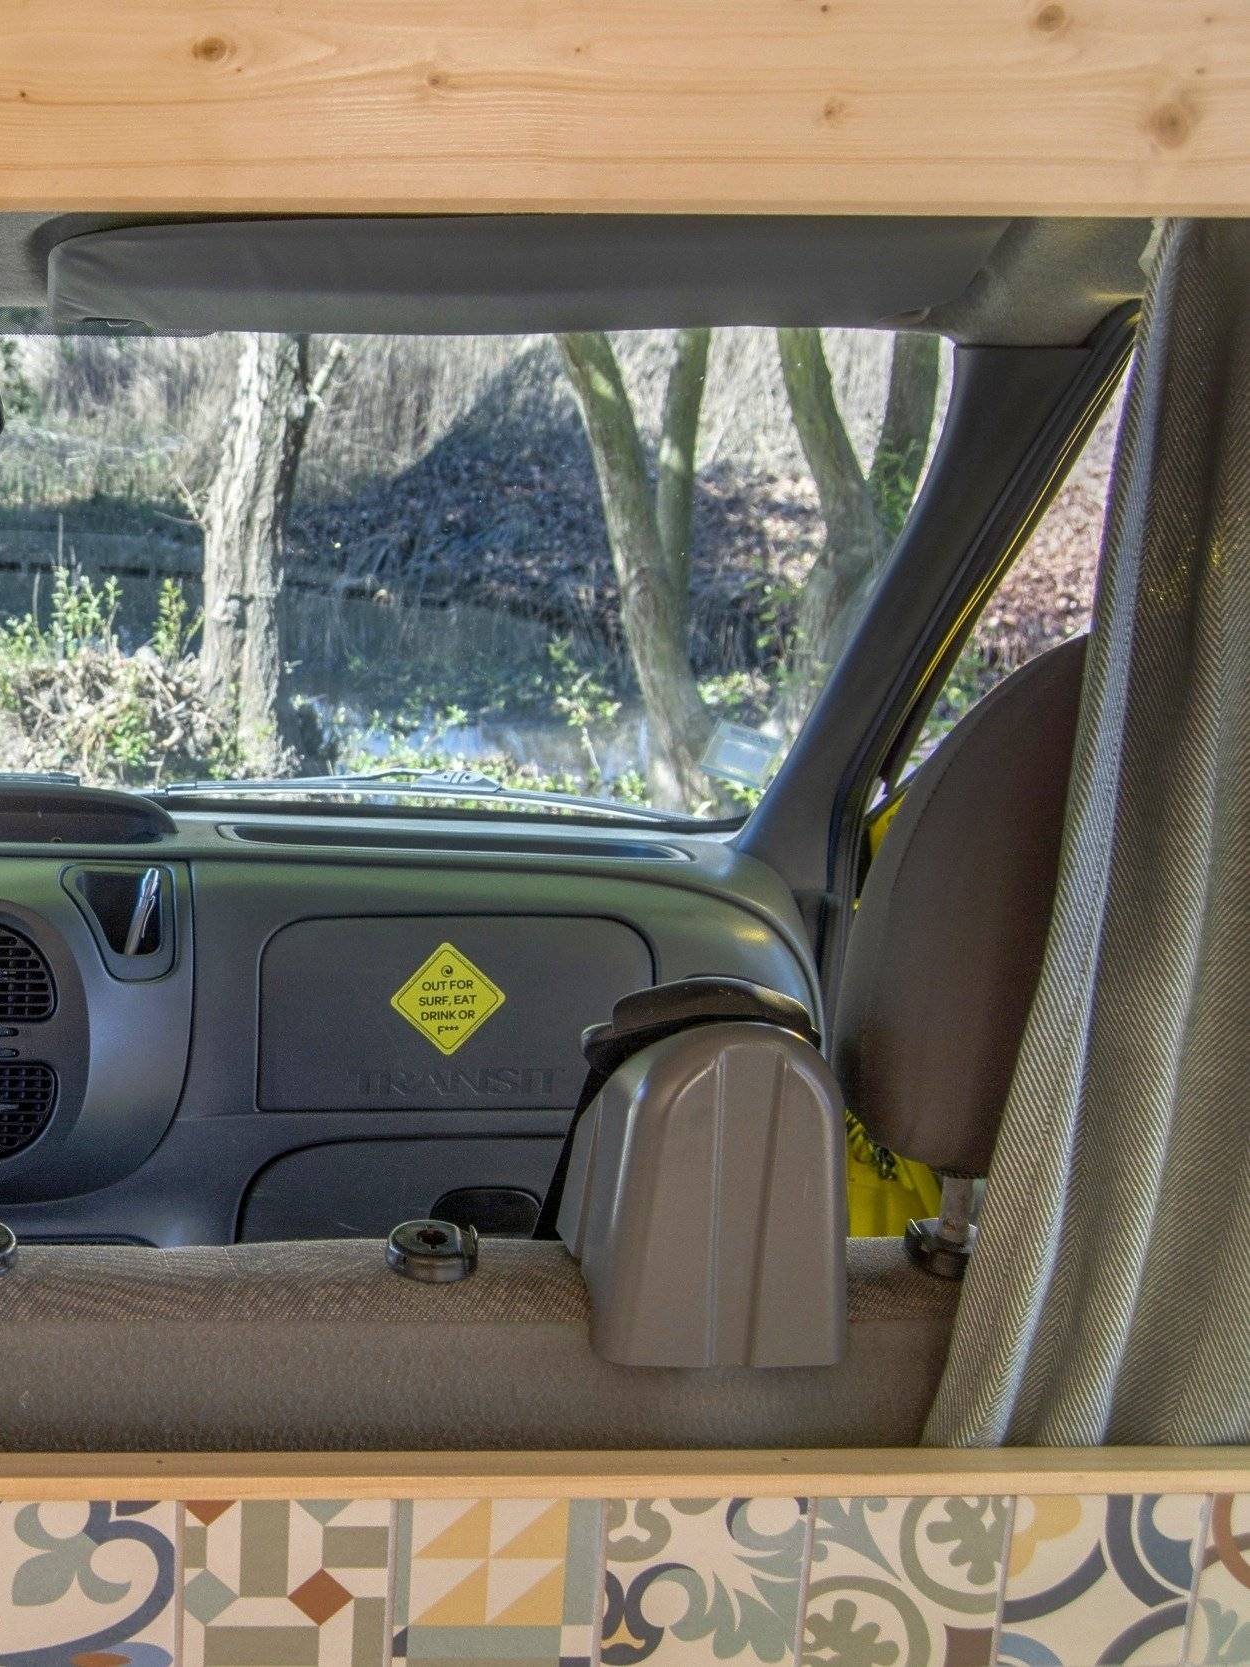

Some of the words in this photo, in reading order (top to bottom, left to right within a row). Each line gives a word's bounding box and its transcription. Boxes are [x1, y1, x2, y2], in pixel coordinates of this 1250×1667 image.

[421, 980, 448, 991] OUT
[450, 979, 474, 990] FOR
[418, 996, 452, 1007] SURF,
[454, 994, 477, 1005] EAT
[421, 1010, 457, 1021] DRINK
[458, 1009, 476, 1020] OR
[347, 1067, 561, 1096] TRANSIT
